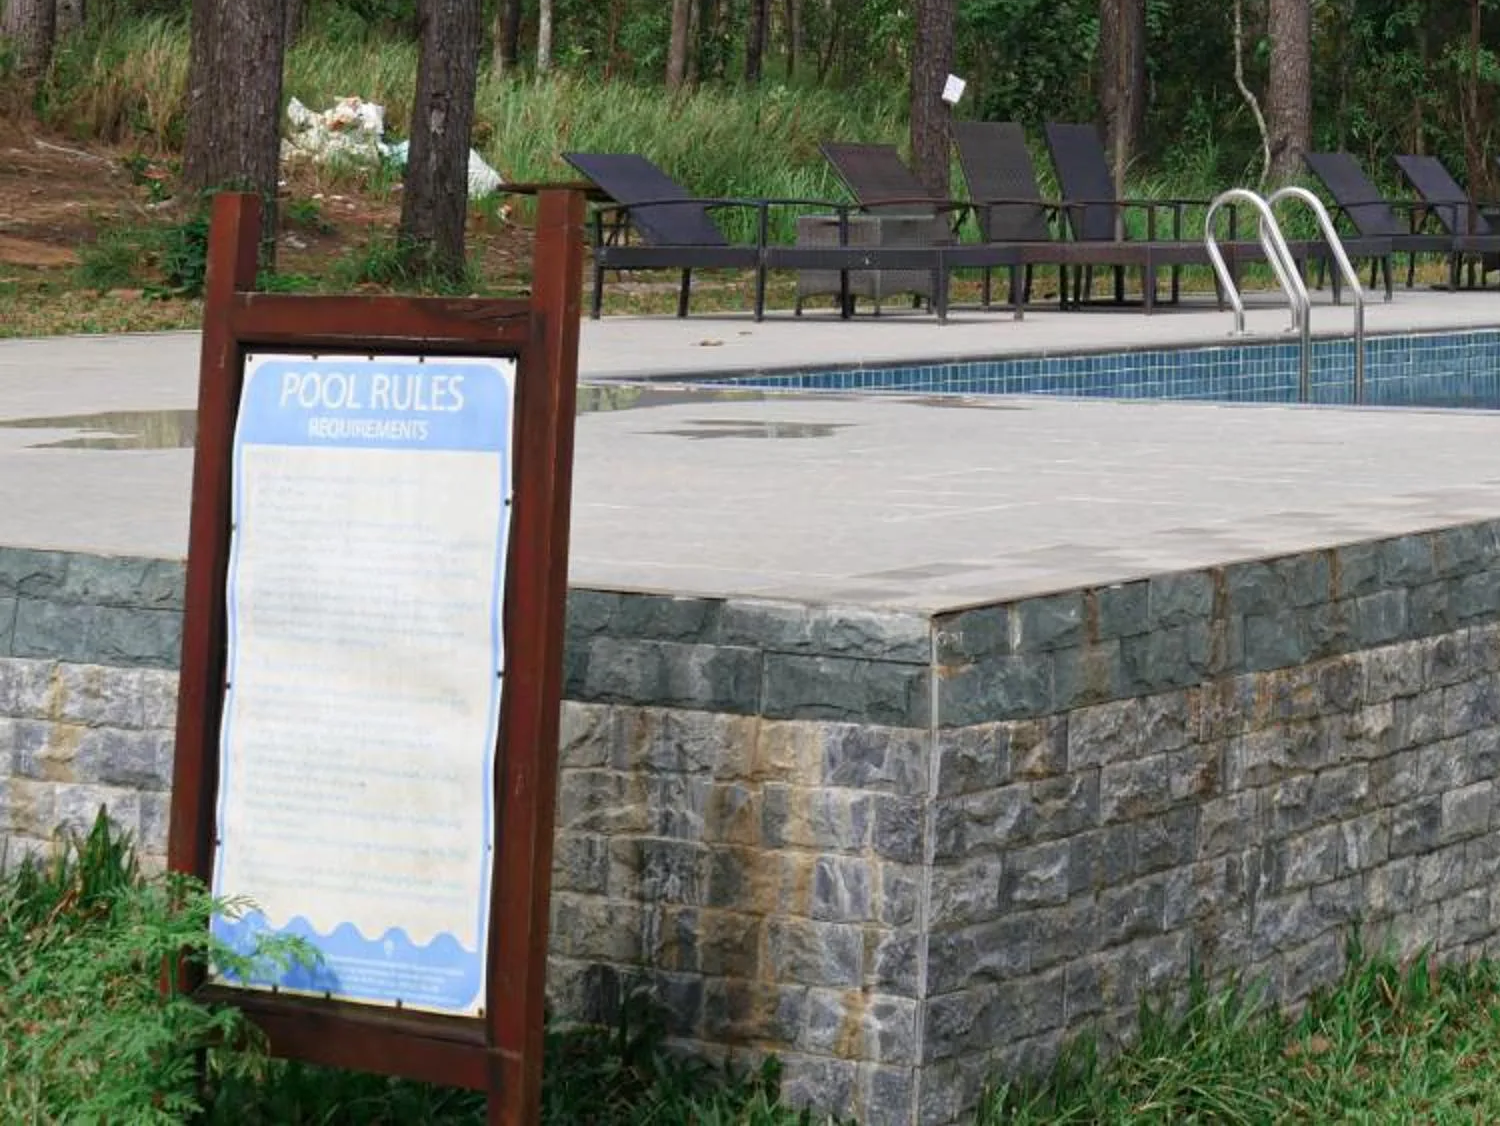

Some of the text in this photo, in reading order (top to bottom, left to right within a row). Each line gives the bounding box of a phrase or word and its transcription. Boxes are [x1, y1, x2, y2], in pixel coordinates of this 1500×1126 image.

[280, 371, 465, 412] POOL RULES
[308, 417, 429, 441] REQUIREMENTS
